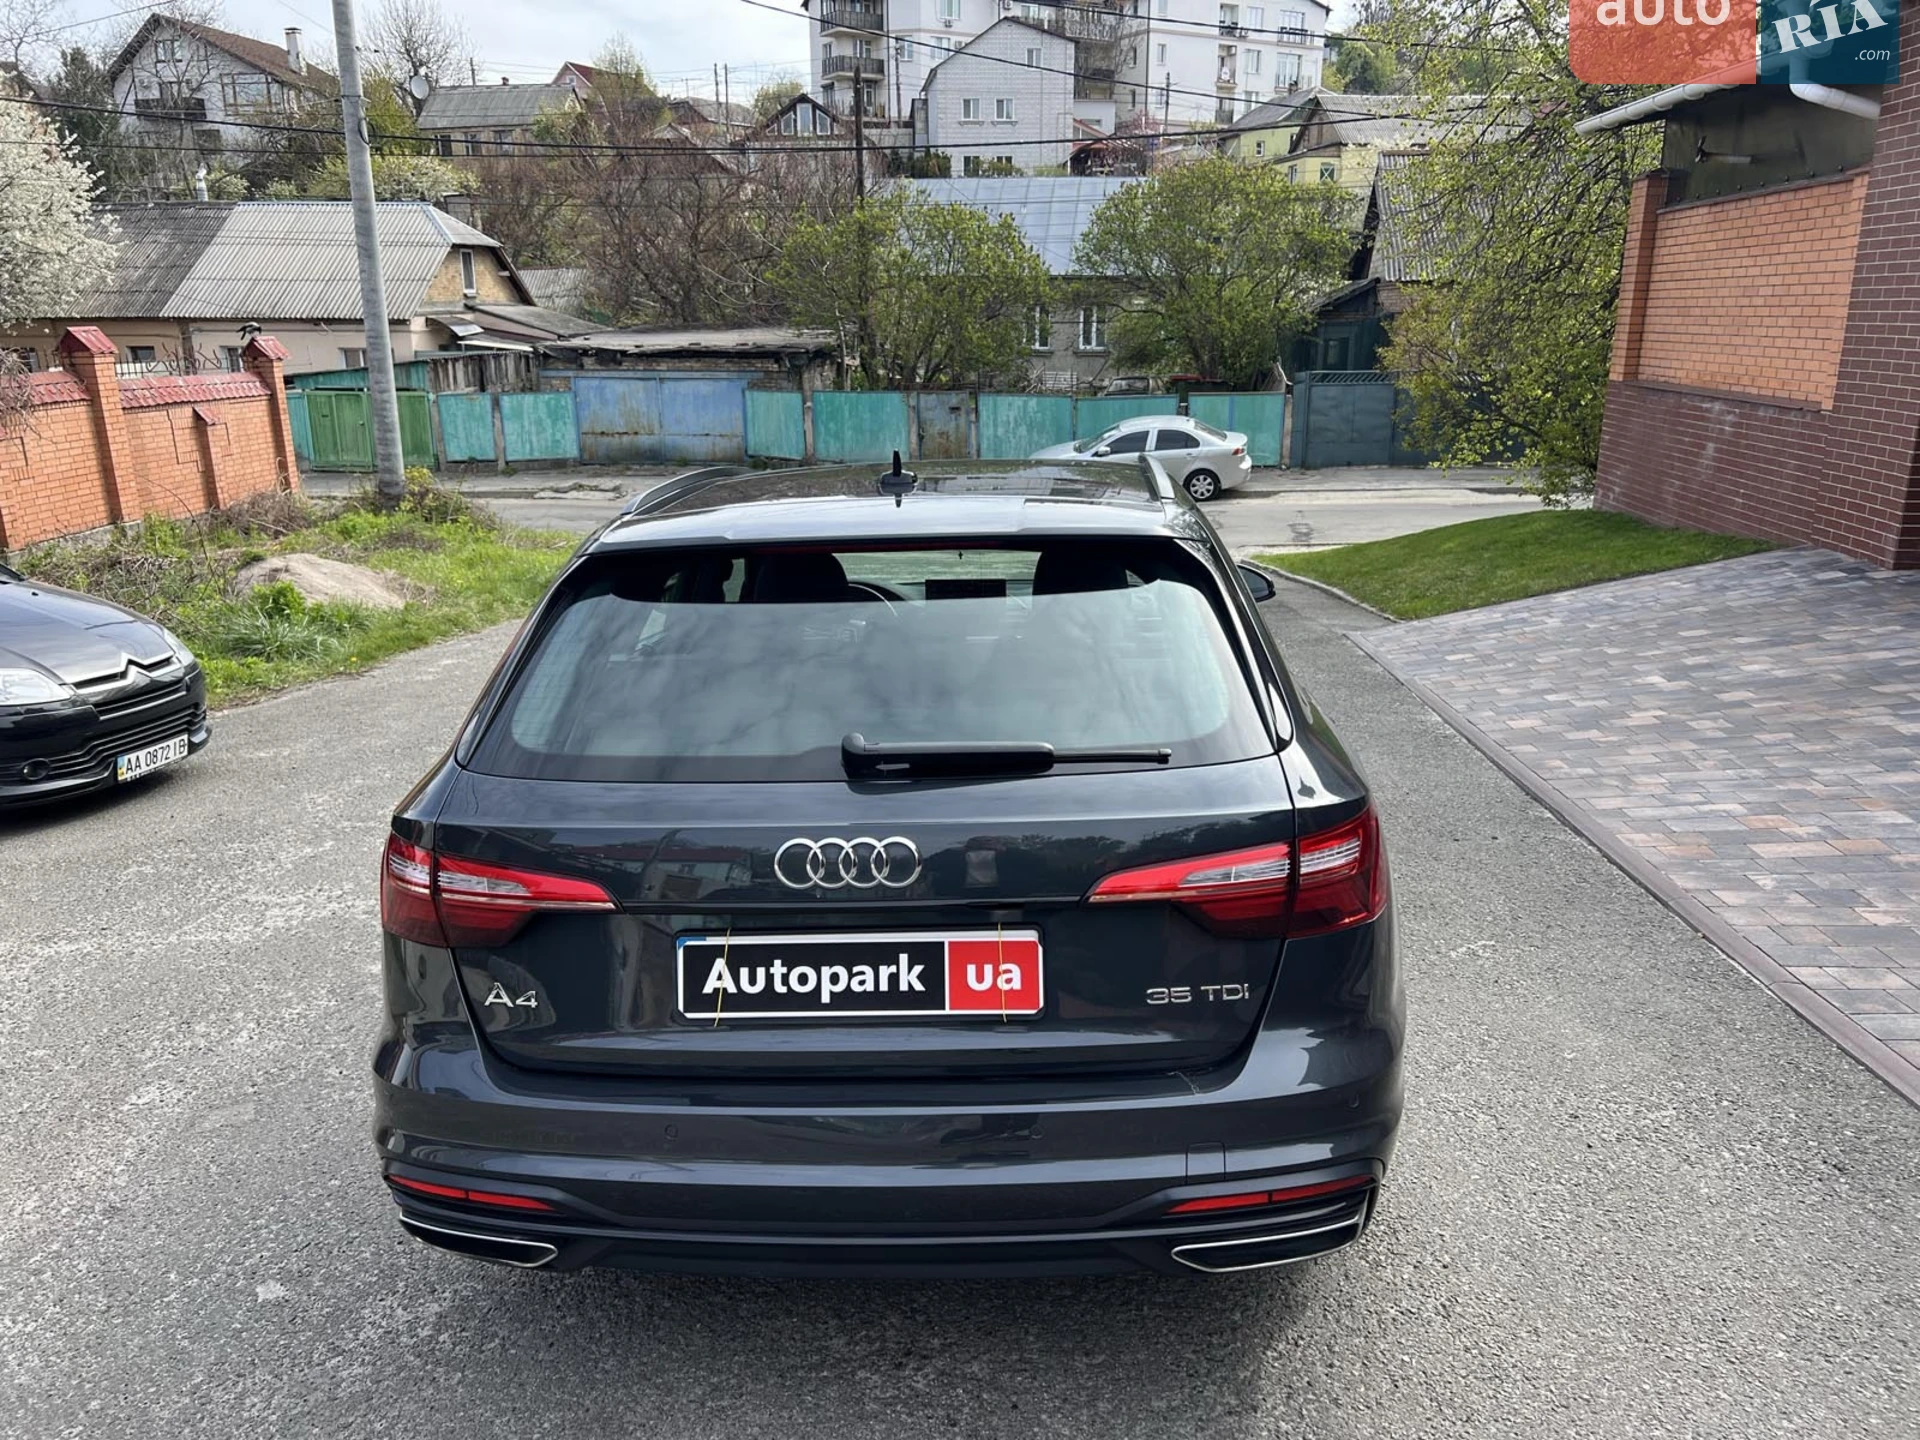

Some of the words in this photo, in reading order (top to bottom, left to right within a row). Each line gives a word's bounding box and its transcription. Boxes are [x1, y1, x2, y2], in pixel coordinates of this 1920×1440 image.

[126, 754, 142, 774] AA
[145, 744, 171, 767] 0872
[701, 952, 926, 1004] Autopark
[966, 963, 1022, 991] ua
[484, 982, 538, 1008] A4
[1146, 986, 1192, 1004] 35
